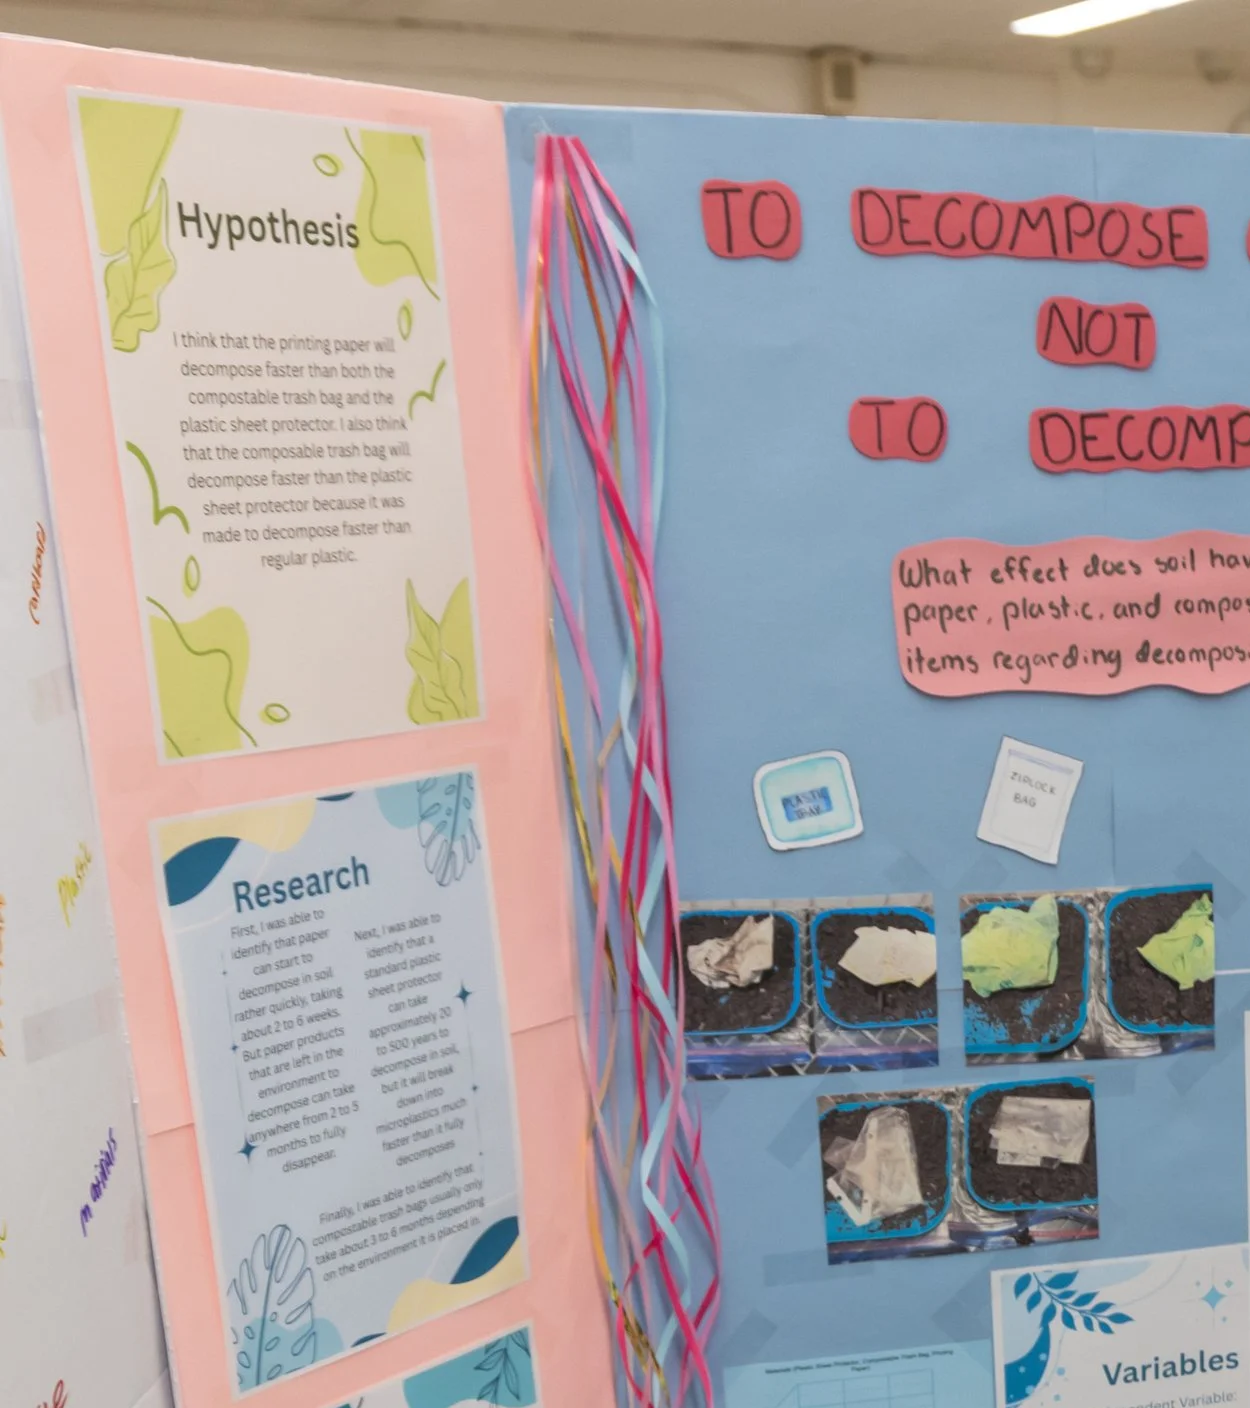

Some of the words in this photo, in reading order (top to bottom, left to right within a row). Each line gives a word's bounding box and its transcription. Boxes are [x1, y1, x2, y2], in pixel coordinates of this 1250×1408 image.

[177, 201, 360, 251] Hypothesis
[705, 188, 791, 253] TO
[858, 191, 1205, 262] DECOMPOSE
[1044, 303, 1151, 361] NOT
[182, 334, 217, 348] think
[220, 334, 249, 350] that
[254, 334, 276, 350] the
[280, 337, 332, 355] printing
[335, 339, 370, 354] paper
[374, 337, 394, 352] will
[181, 362, 262, 379] decompose
[266, 362, 304, 378] faster
[308, 364, 338, 378] than
[341, 364, 371, 378] both
[375, 365, 394, 379] the
[189, 390, 279, 408] compostable
[282, 391, 316, 405] trash
[320, 390, 344, 408] bag
[346, 390, 370, 405] and
[373, 391, 393, 404] the
[180, 418, 227, 436] plastic
[231, 418, 268, 432] sheet
[347, 418, 373, 431] also
[376, 416, 408, 431] think
[858, 400, 945, 456] TO
[184, 445, 213, 461] that
[217, 445, 238, 460] the
[327, 443, 360, 457] trash
[364, 443, 386, 460] bag
[390, 442, 411, 456] will
[187, 472, 268, 490] decompose
[272, 471, 311, 485] faster
[315, 471, 343, 484] than
[346, 470, 367, 484] the
[371, 468, 412, 486] plastic
[203, 500, 241, 516] sheet
[246, 499, 309, 518] protector
[313, 496, 366, 510] because
[370, 496, 378, 509] it
[382, 496, 405, 508] was
[203, 527, 241, 543] made
[245, 528, 259, 541] to
[263, 524, 339, 541] decompose
[343, 522, 379, 536] faster
[383, 520, 412, 534] than
[261, 551, 308, 570] regular
[899, 559, 972, 589] What
[991, 556, 1069, 585] effect
[1084, 552, 1142, 578] does
[1155, 548, 1195, 572] soil
[1114, 593, 1161, 619] and
[906, 647, 979, 674] items
[993, 645, 1122, 684] regarding
[233, 856, 370, 914] Research
[1102, 1350, 1239, 1386] Variables
